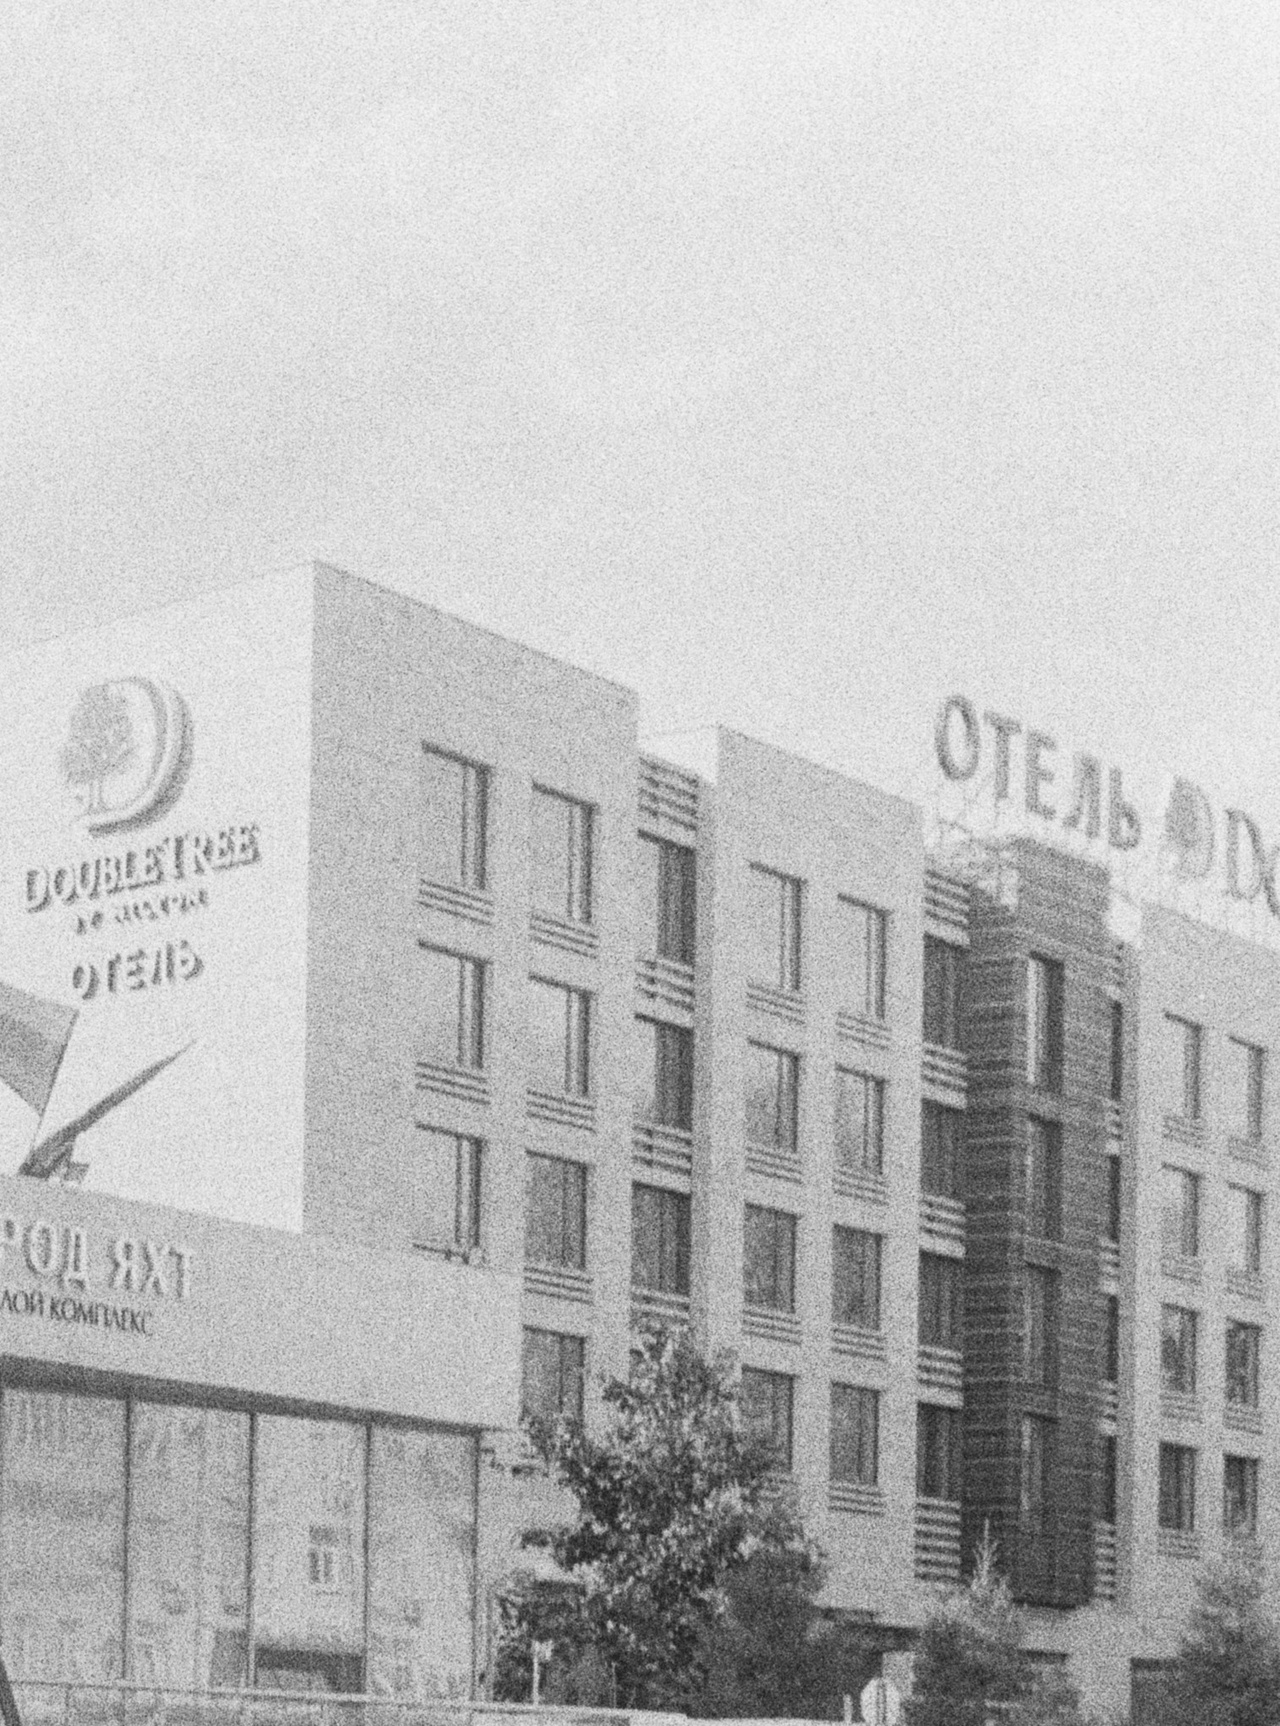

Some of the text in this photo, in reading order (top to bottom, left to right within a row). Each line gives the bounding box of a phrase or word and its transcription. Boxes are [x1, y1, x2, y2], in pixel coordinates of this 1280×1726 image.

[934, 694, 1142, 850] ОТЕЛЬ
[25, 823, 261, 913] DOUBLETREE
[72, 939, 205, 1000] ОТЕЛЬ
[106, 1236, 193, 1299] ЯХТ
[49, 1297, 153, 1337] КОМПЛЕКС
